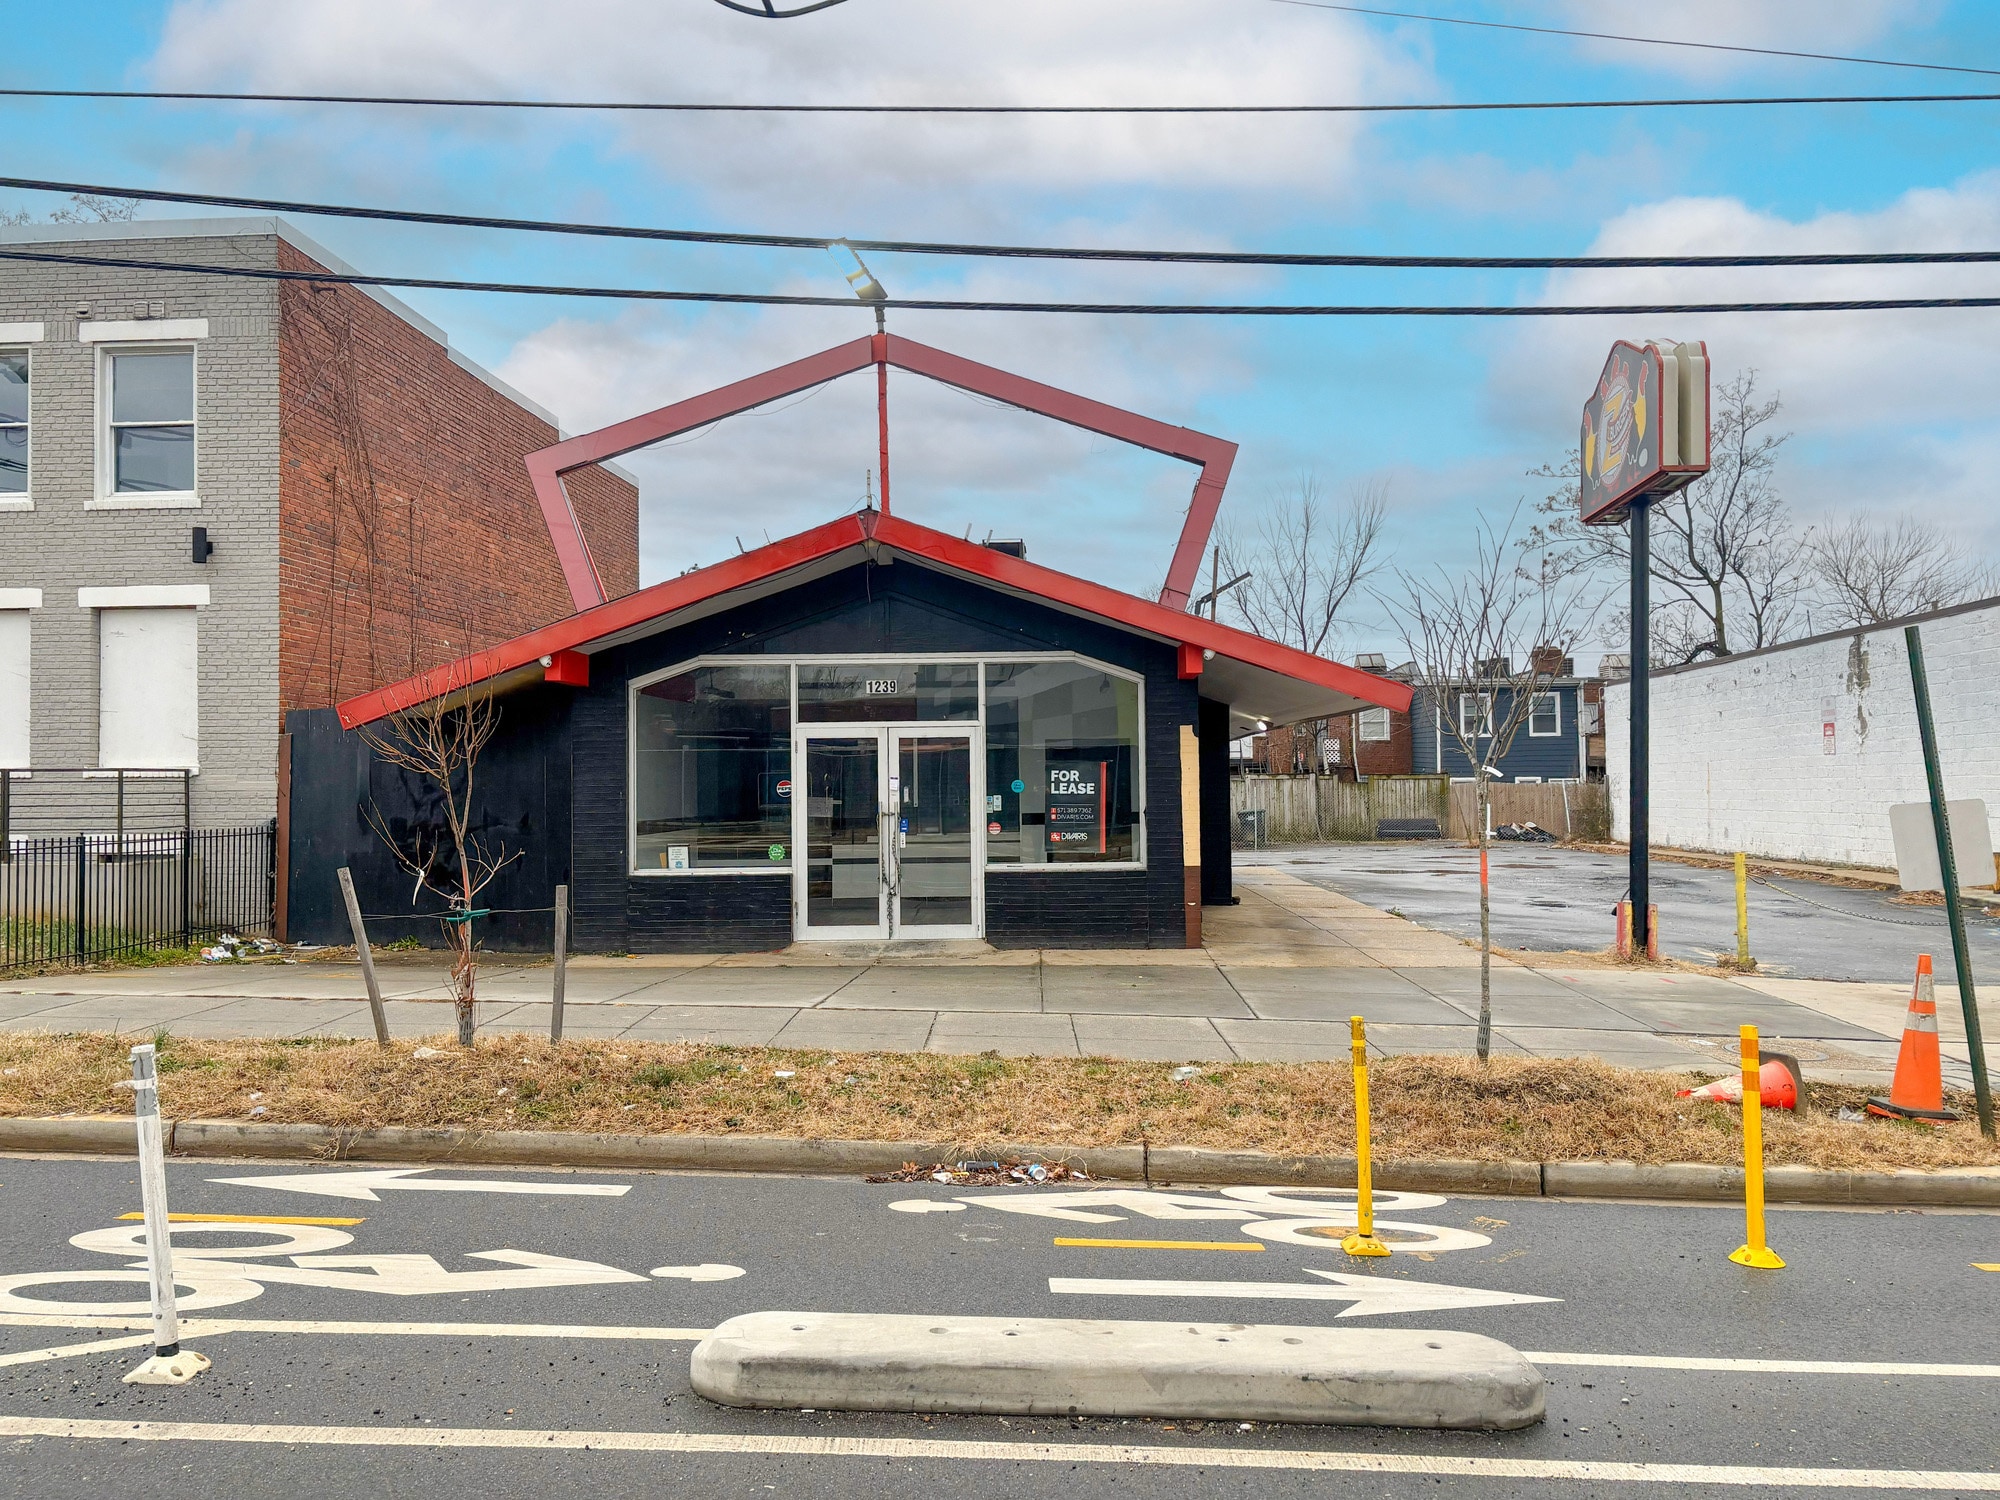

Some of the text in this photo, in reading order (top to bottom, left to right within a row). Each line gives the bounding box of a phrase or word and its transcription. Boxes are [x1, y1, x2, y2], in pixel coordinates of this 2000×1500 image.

[867, 680, 896, 693] 1239
[1050, 770, 1080, 782] FOR
[1050, 783, 1095, 794] LEASE
[1061, 832, 1088, 840] DIVARIS
